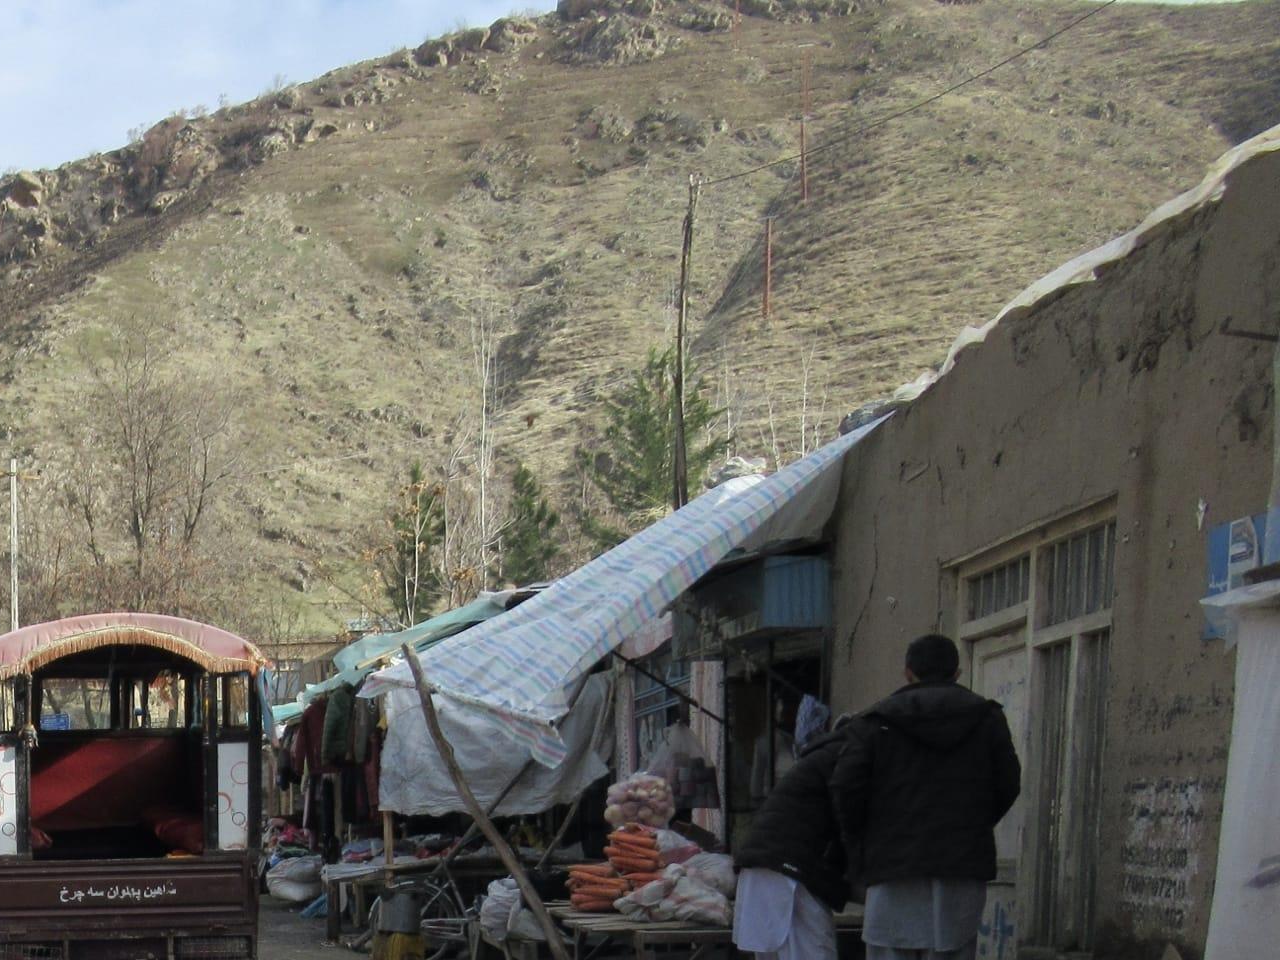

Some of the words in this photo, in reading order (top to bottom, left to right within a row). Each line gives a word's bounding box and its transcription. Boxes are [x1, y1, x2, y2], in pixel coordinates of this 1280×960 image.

[60, 886, 85, 903] چرخ
[87, 886, 105, 897] سه
[107, 885, 141, 901] پهلوان
